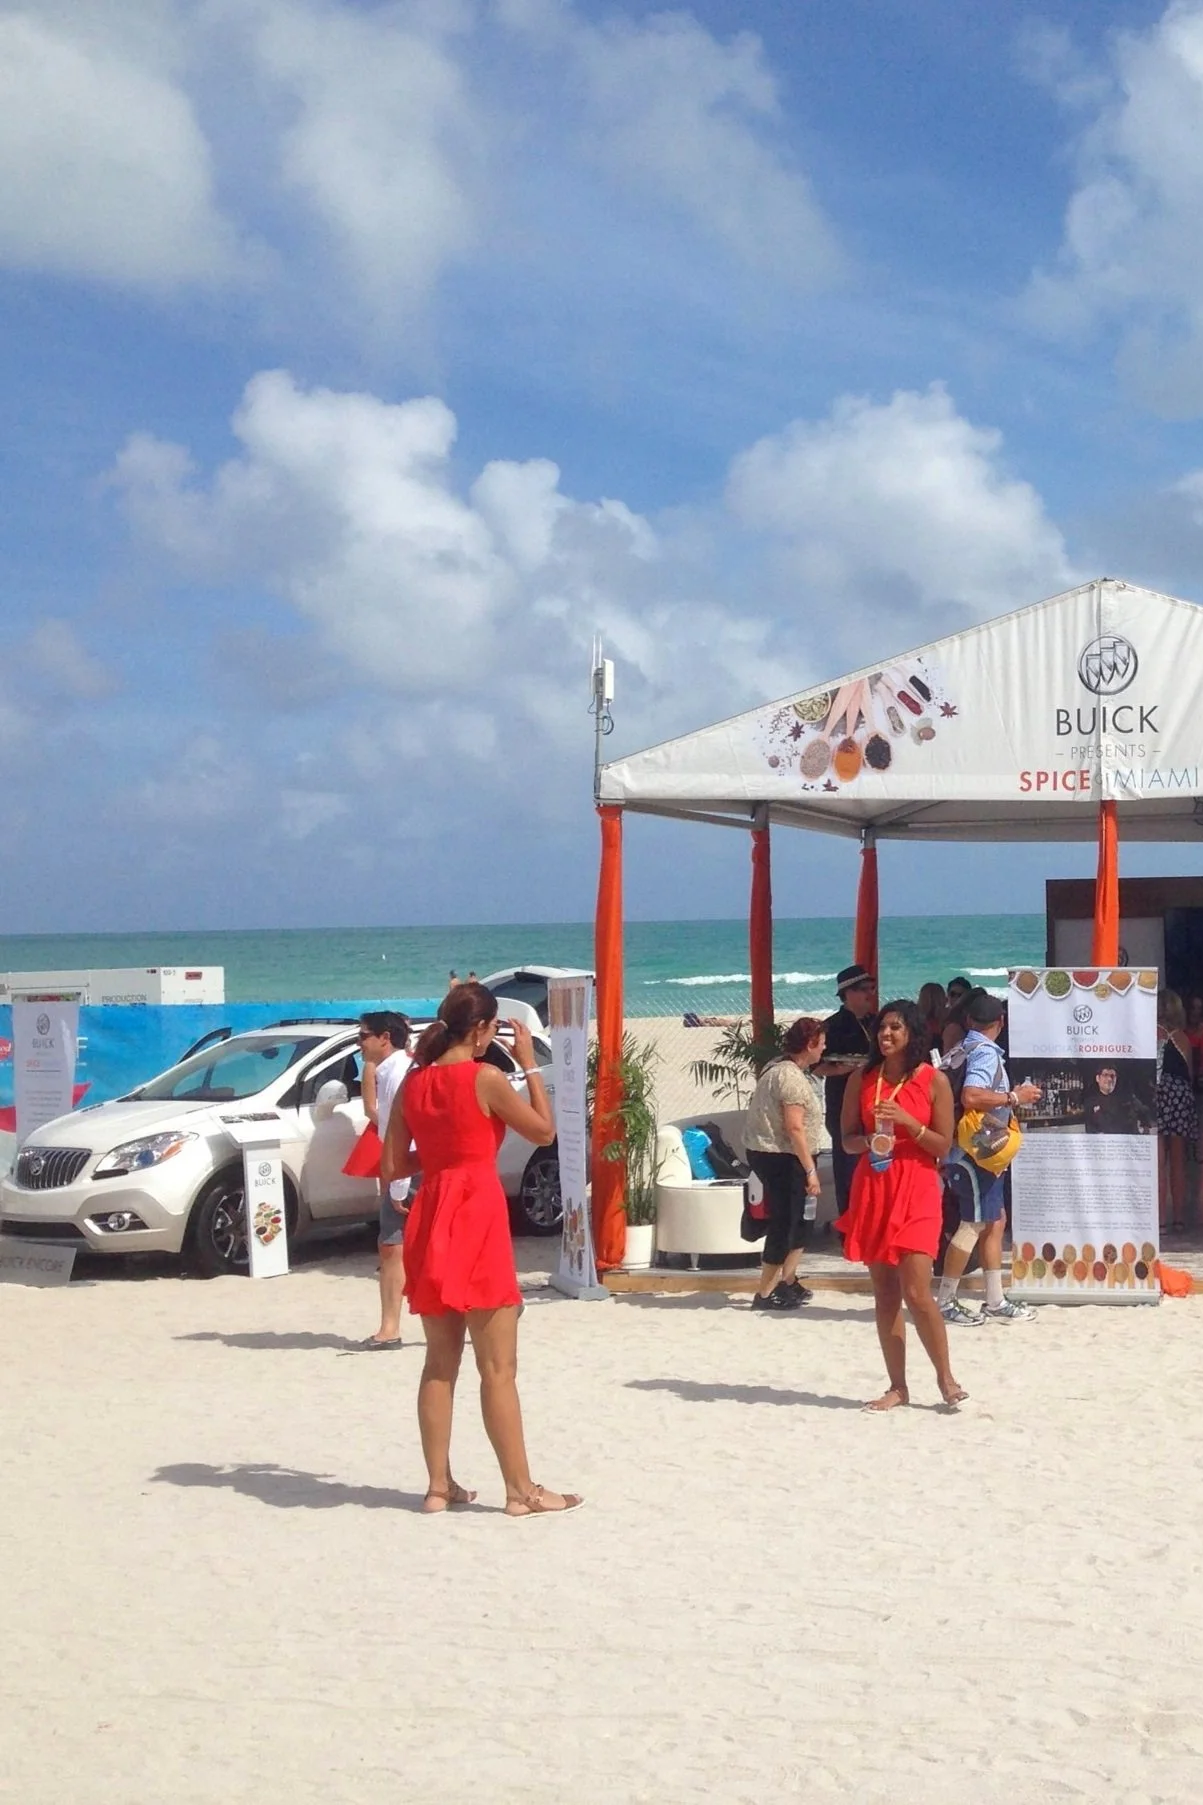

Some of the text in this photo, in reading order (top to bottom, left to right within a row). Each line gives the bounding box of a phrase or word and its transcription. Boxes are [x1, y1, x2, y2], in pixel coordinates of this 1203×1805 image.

[1056, 705, 1160, 736] BUICK
[1070, 743, 1147, 760] PRESENTS
[1019, 769, 1091, 792] SPICE
[1112, 766, 1200, 789] MIAMI
[1066, 1025, 1099, 1036] BUICK
[1078, 1044, 1133, 1053] RODRIGUEZ
[254, 1178, 277, 1188] BUICK
